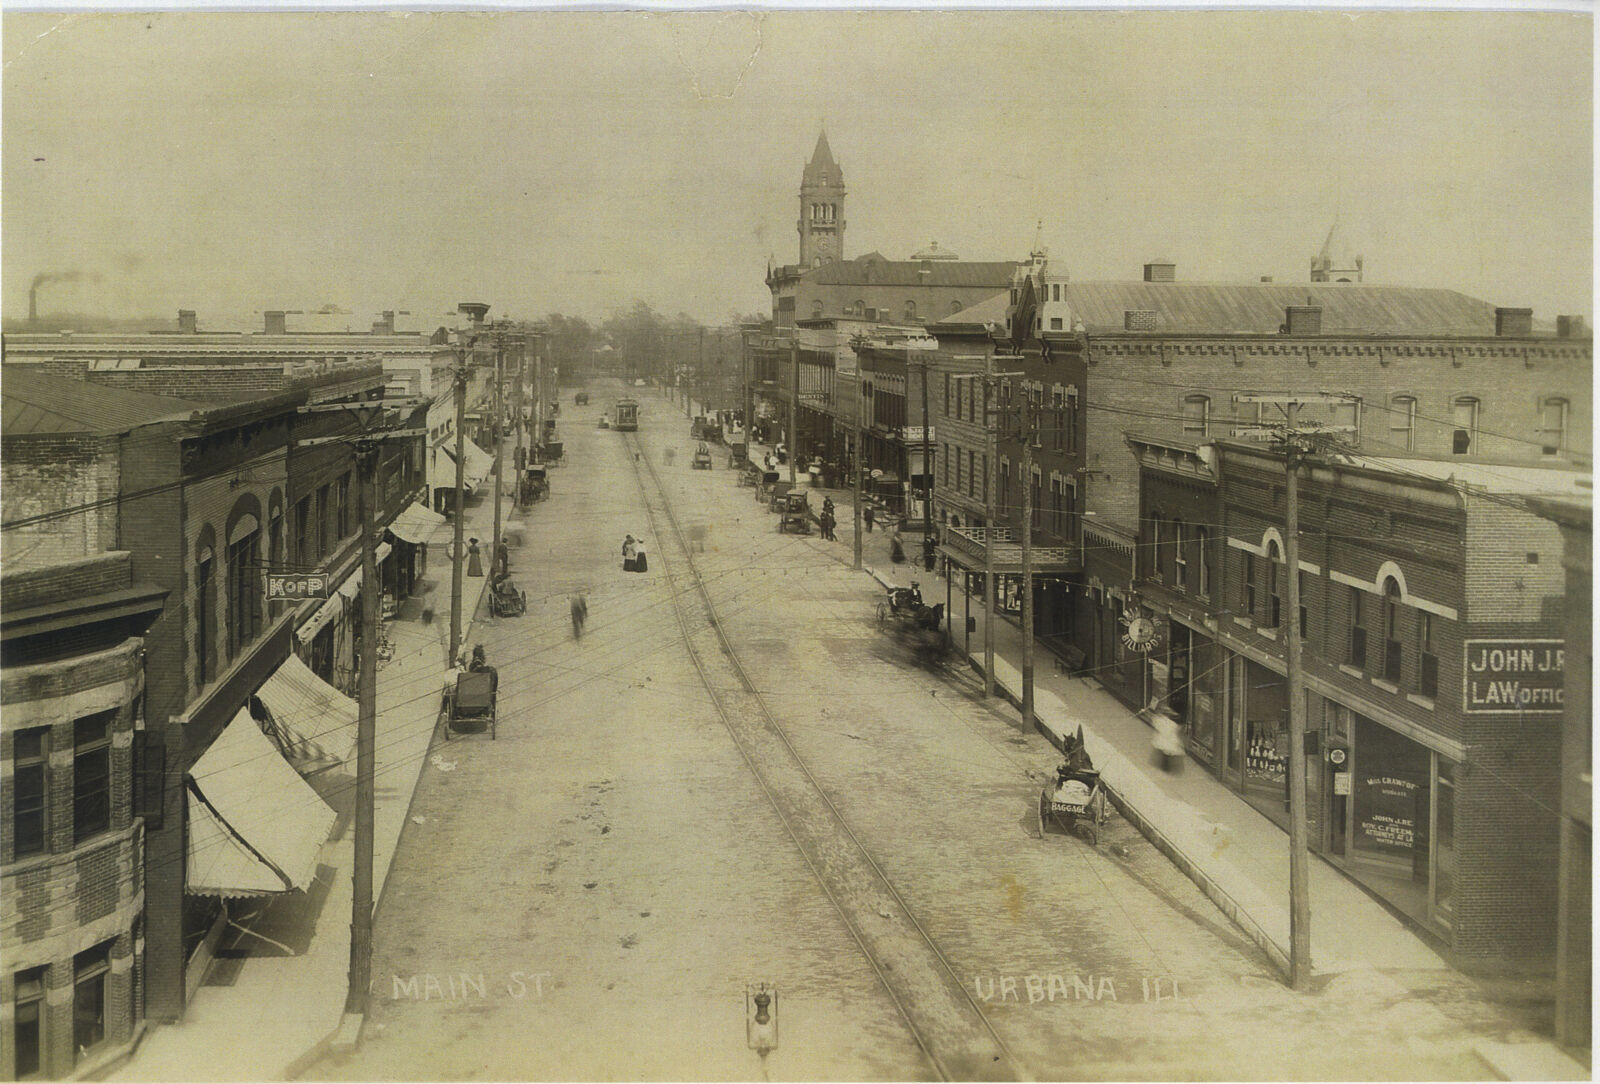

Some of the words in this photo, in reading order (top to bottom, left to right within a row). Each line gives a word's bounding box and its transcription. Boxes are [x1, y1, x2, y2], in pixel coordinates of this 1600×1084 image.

[1471, 649, 1534, 672] JOHN
[1472, 681, 1519, 704] LAW
[1051, 801, 1086, 814] BAGGAGE
